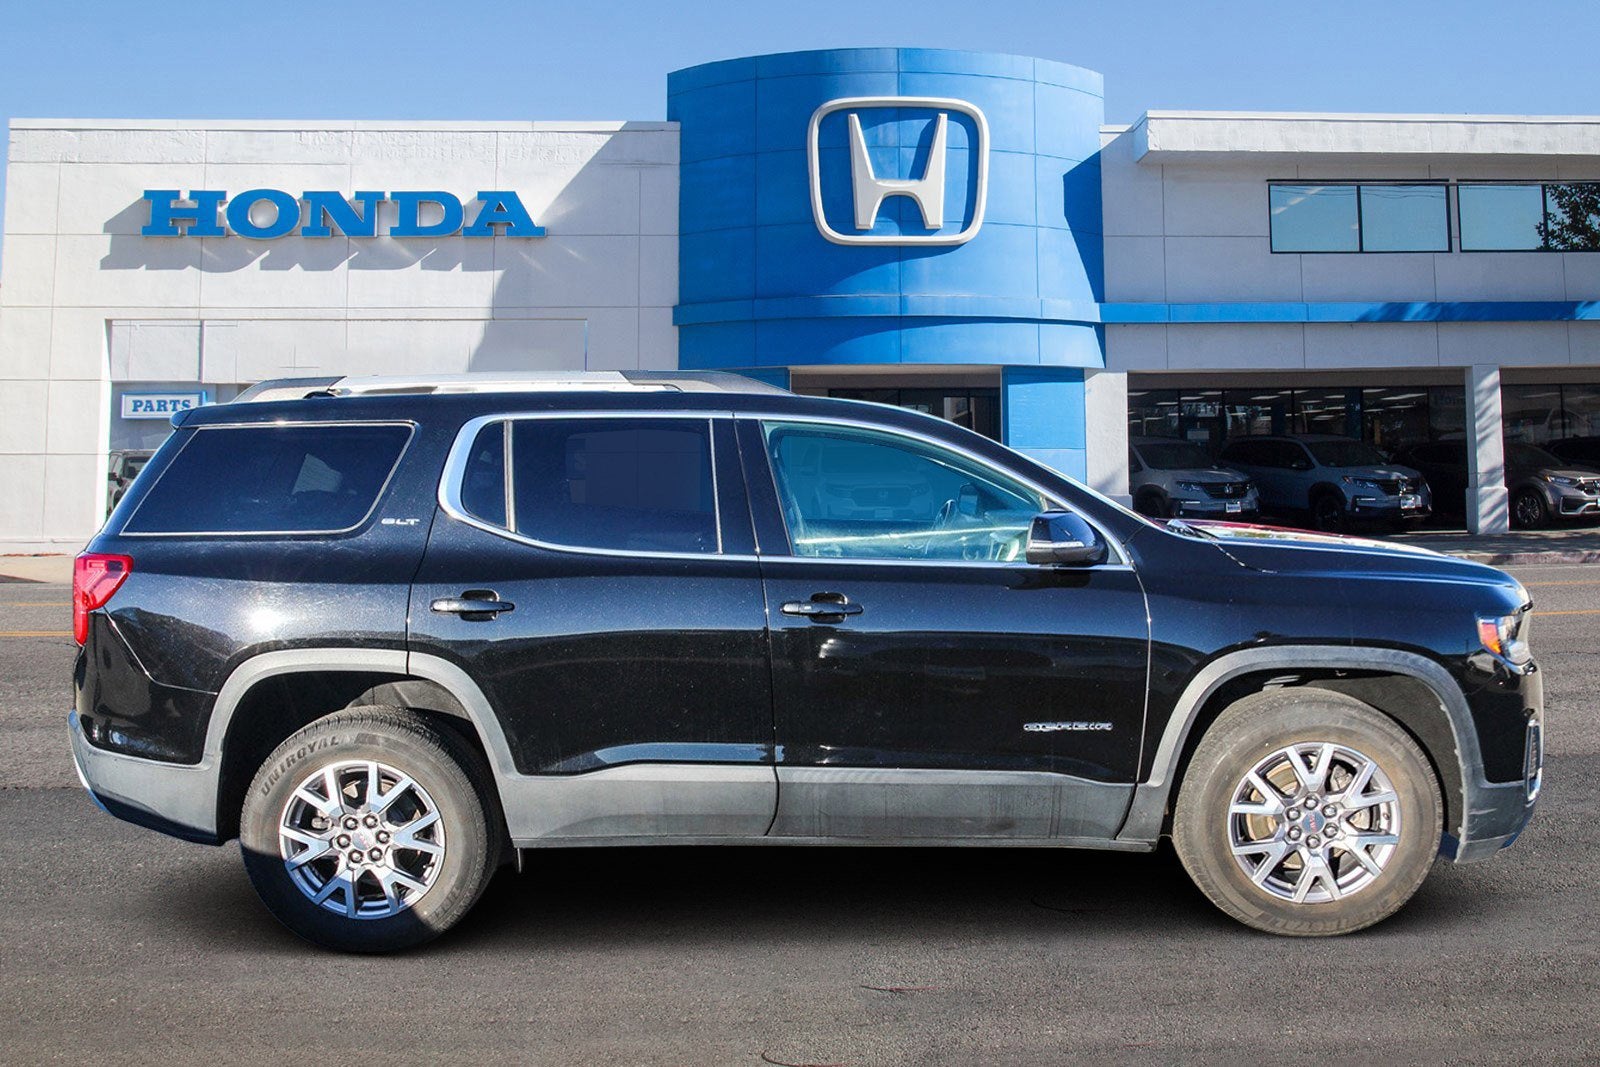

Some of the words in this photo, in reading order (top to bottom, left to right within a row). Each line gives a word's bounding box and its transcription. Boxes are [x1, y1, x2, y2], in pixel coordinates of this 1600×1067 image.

[142, 188, 548, 238] HONDA
[132, 399, 191, 412] PARTS
[260, 735, 339, 797] UNIROYAL
